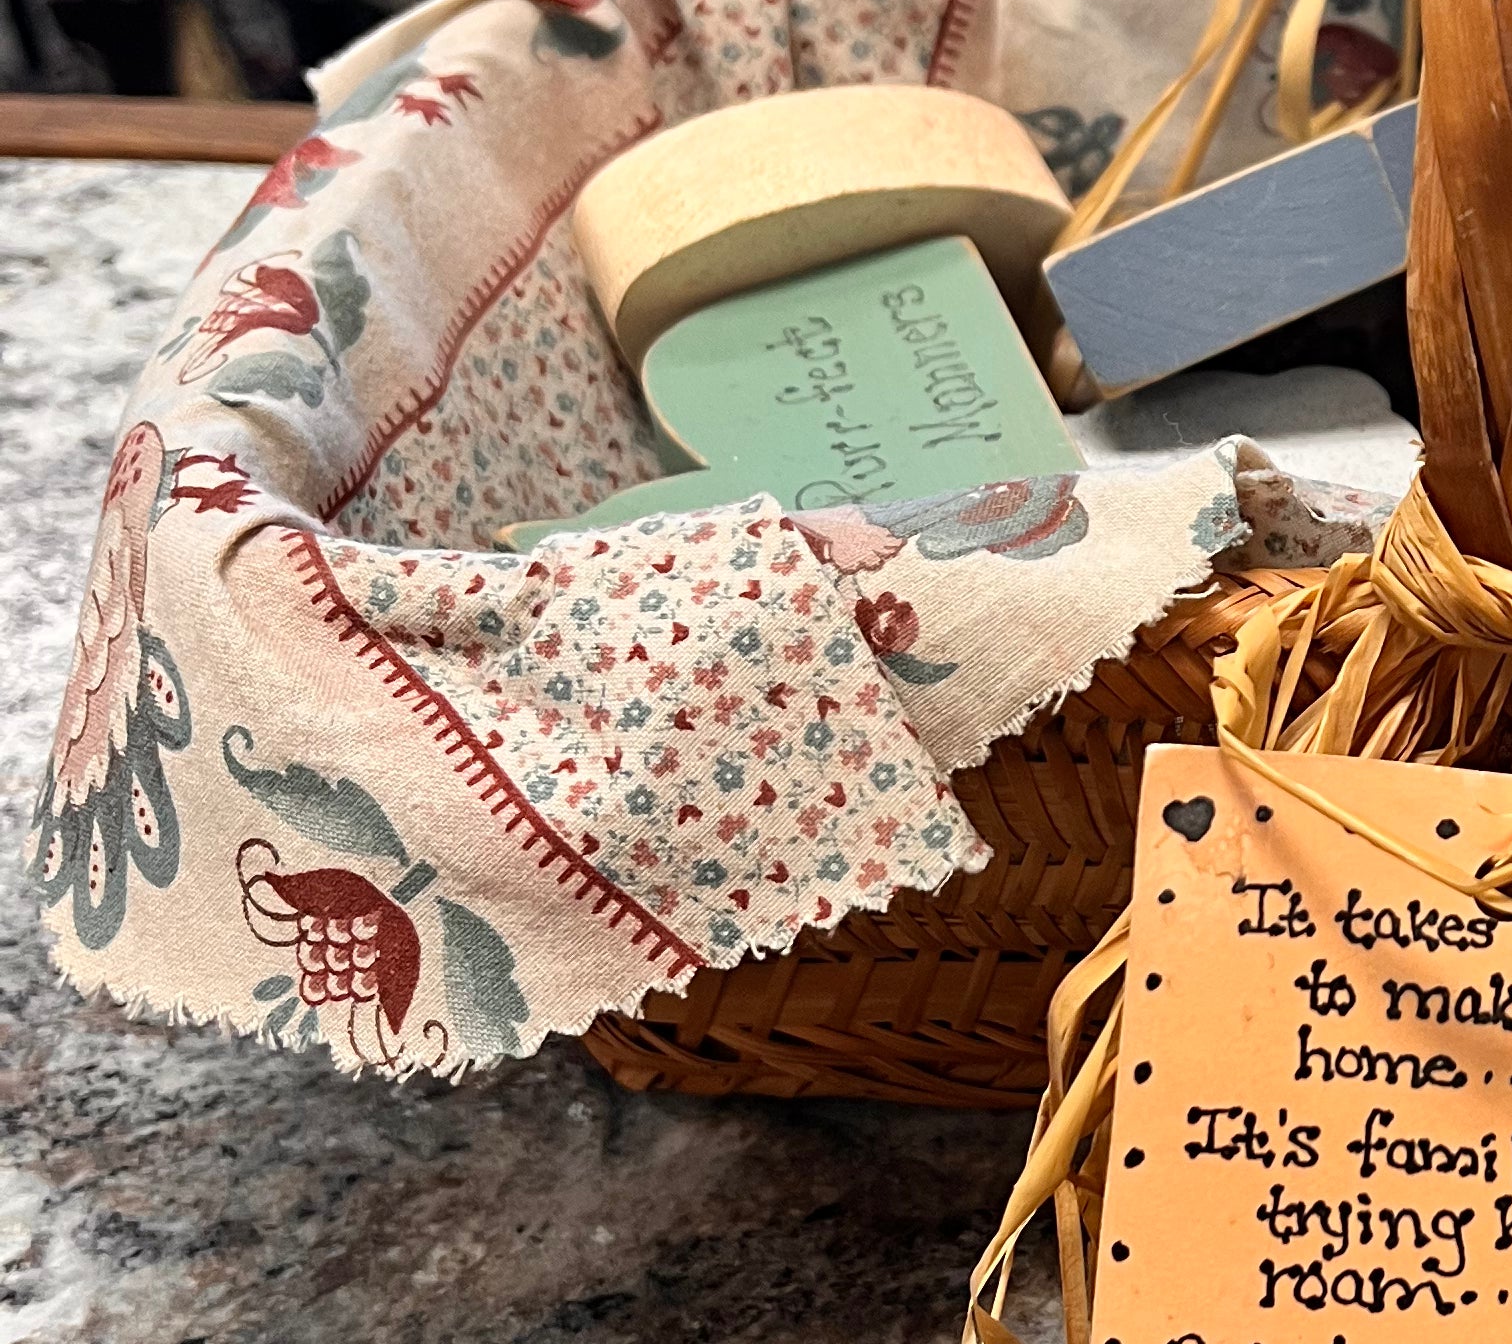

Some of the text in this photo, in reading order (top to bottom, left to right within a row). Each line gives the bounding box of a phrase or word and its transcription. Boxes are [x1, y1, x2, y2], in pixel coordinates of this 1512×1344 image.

[881, 283, 1002, 449] Manners
[1233, 877, 1315, 938] It
[1335, 888, 1496, 952] takes
[1296, 958, 1355, 1018] to
[1185, 1106, 1321, 1168] It's
[1257, 1184, 1474, 1277] trying
